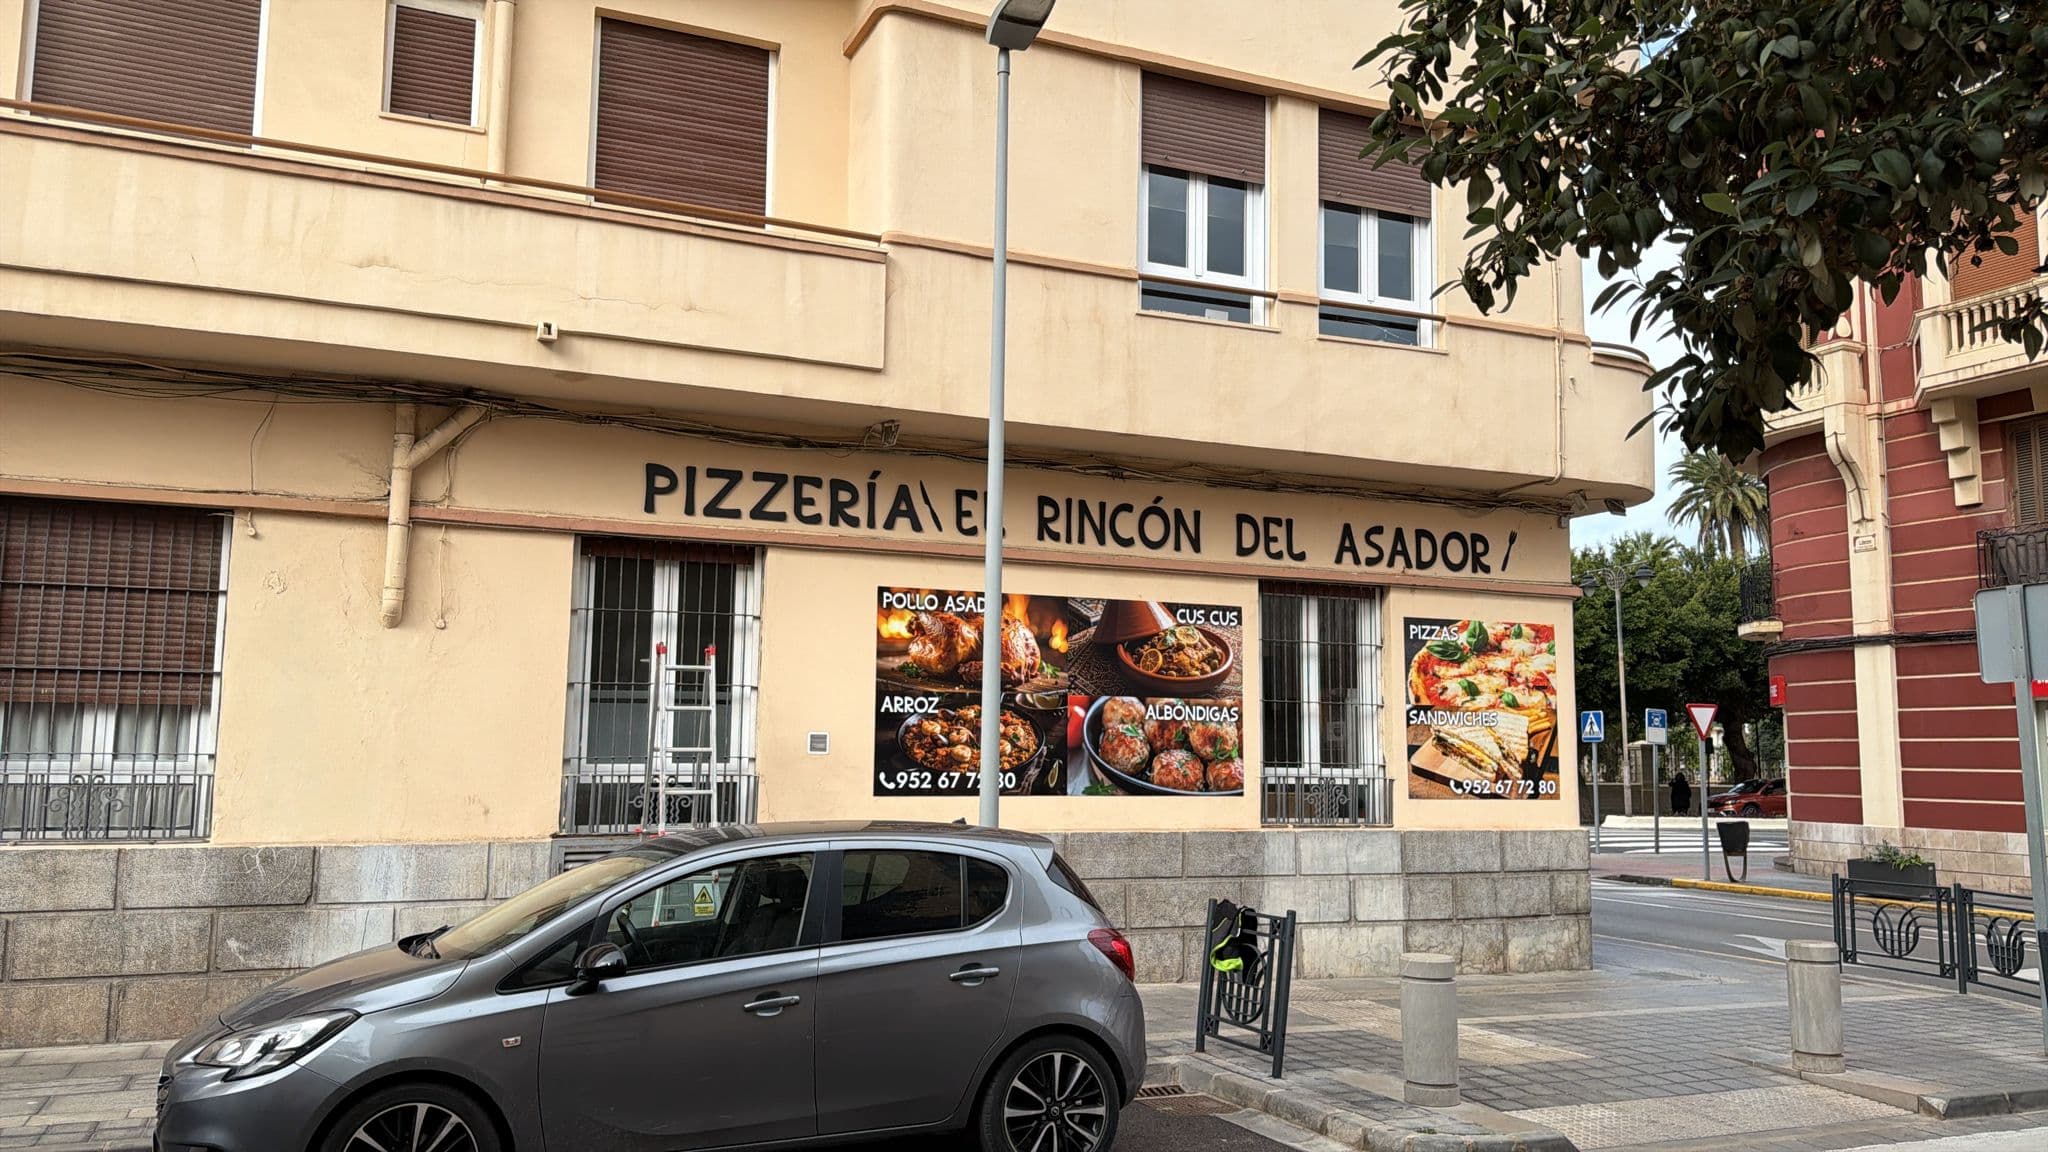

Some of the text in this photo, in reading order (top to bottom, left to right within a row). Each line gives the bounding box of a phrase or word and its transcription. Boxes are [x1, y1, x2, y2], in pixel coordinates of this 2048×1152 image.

[644, 462, 924, 533] PIZZERÍA
[1037, 495, 1201, 554] RINCÓN
[1235, 513, 1306, 561] DEL
[1334, 523, 1490, 574] ASADOR
[882, 592, 987, 613] POLLO ASAD
[1177, 608, 1239, 627] CUS CUS
[1409, 625, 1459, 641] PIZZAS
[880, 696, 939, 715] ARROZ
[1145, 701, 1239, 723] ALBÓNDIGAS
[1409, 710, 1499, 727] SANDWICHES
[896, 772, 932, 789] 952
[938, 772, 961, 789] 67
[1462, 780, 1556, 795] 952 67 72 80
